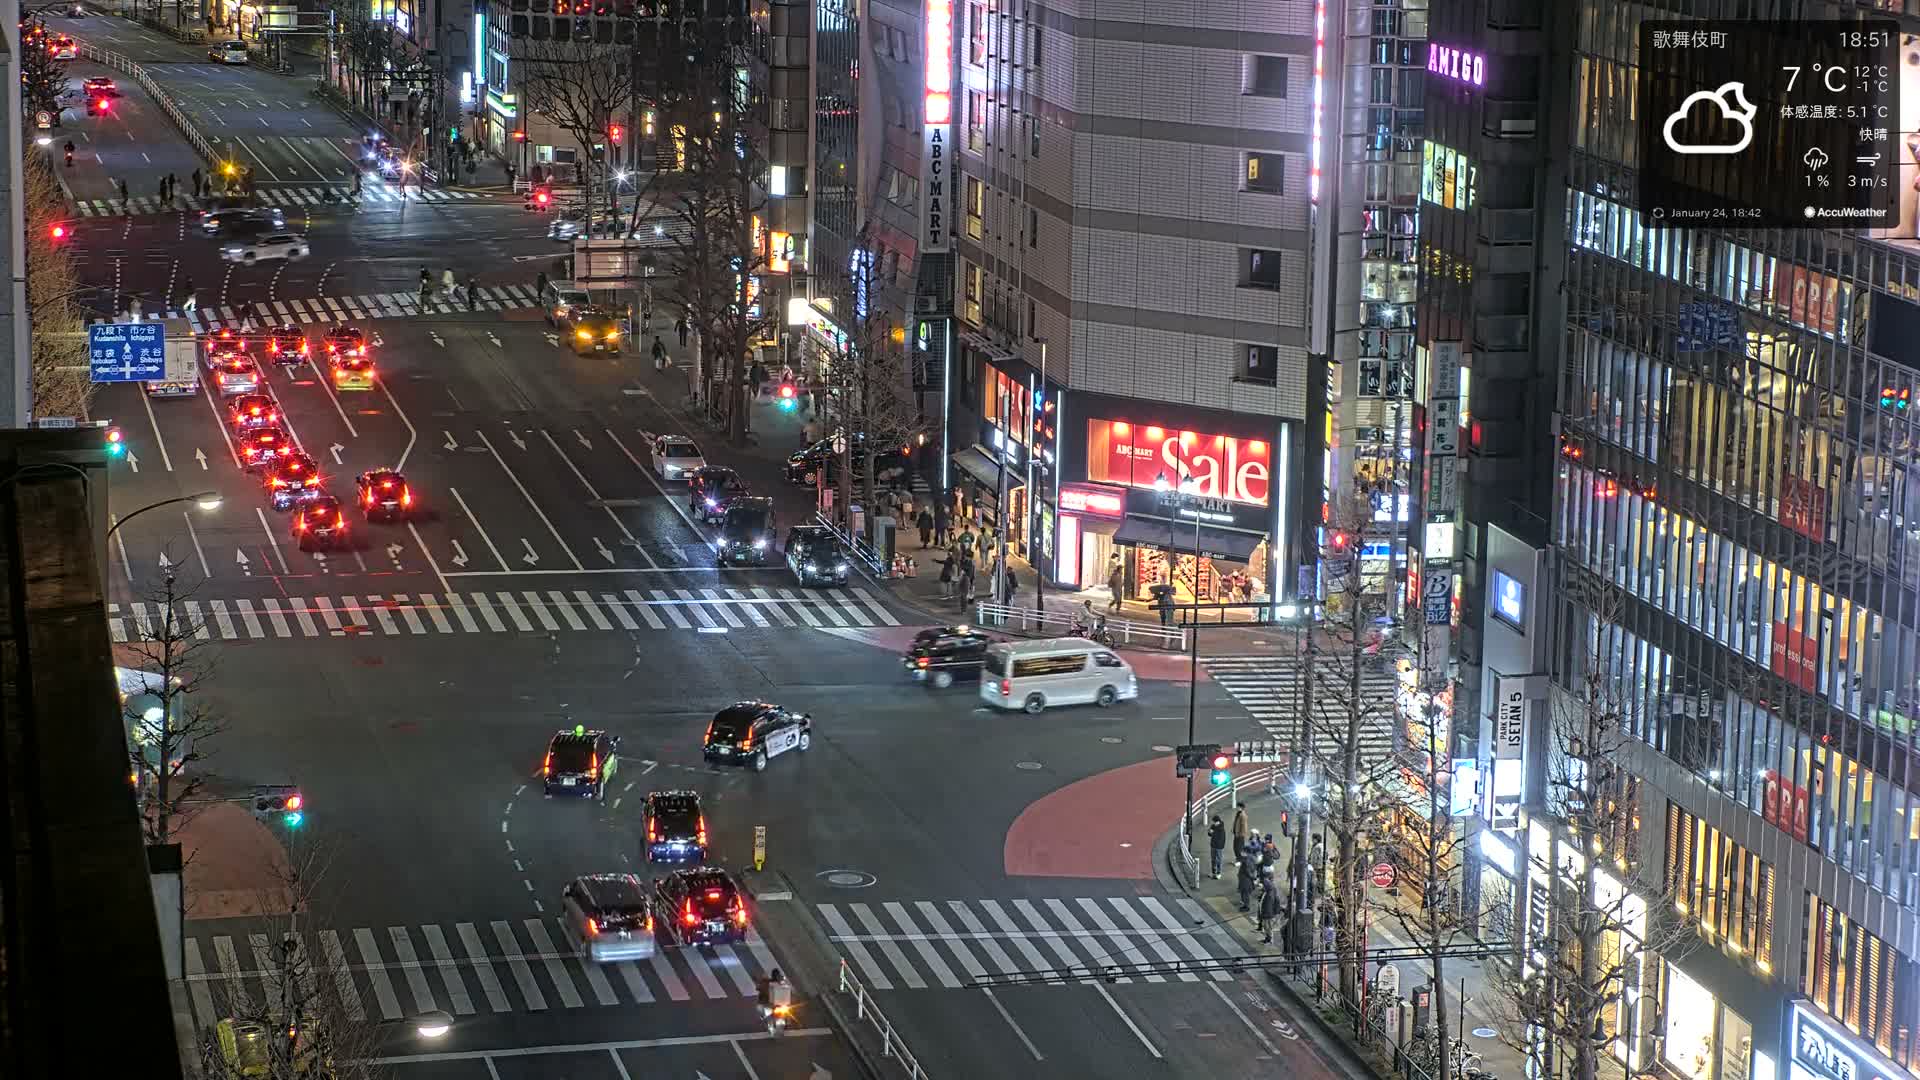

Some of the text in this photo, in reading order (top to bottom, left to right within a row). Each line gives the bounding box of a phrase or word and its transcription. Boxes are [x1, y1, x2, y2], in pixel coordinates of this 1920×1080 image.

[1428, 43, 1483, 85] AMIGO
[96, 326, 124, 335] 九段下
[140, 348, 162, 357] 渋谷
[140, 356, 163, 364] Shibuya
[1161, 437, 1269, 500] Sale
[1435, 515, 1446, 523] 7F
[1773, 641, 1816, 672] professional
[1500, 703, 1509, 740] PARK CITY
[1508, 692, 1522, 747] ISETAN 5
[1767, 780, 1806, 831] CPA
